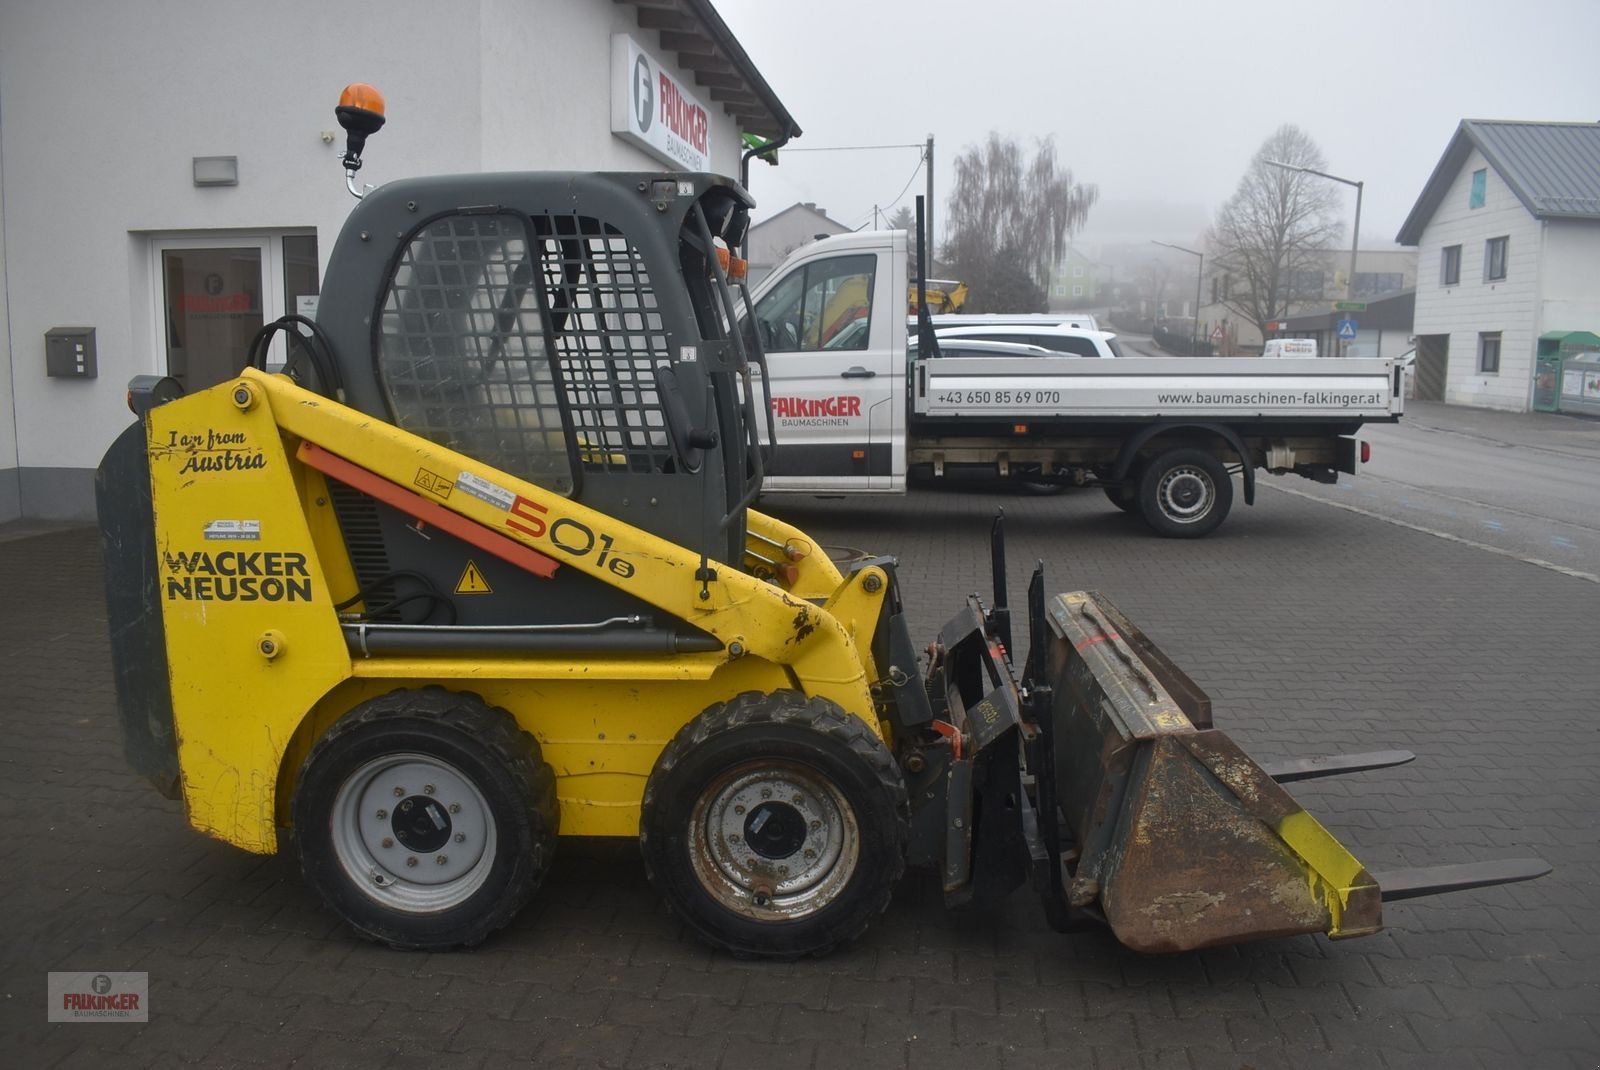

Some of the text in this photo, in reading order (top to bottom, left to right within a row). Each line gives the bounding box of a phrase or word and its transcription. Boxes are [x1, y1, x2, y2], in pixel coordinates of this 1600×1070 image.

[659, 71, 708, 157] FALKINGER
[770, 396, 862, 418] FALKINGER
[938, 391, 1060, 404] +43 650 85 69 070
[1158, 391, 1381, 407] www.baumaschinen-falkinger.at
[781, 418, 849, 427] BAUMASCHINEN
[207, 428, 247, 449] from
[179, 450, 268, 475] Austria
[163, 551, 311, 577] WACKER
[167, 577, 313, 602] NEUSON
